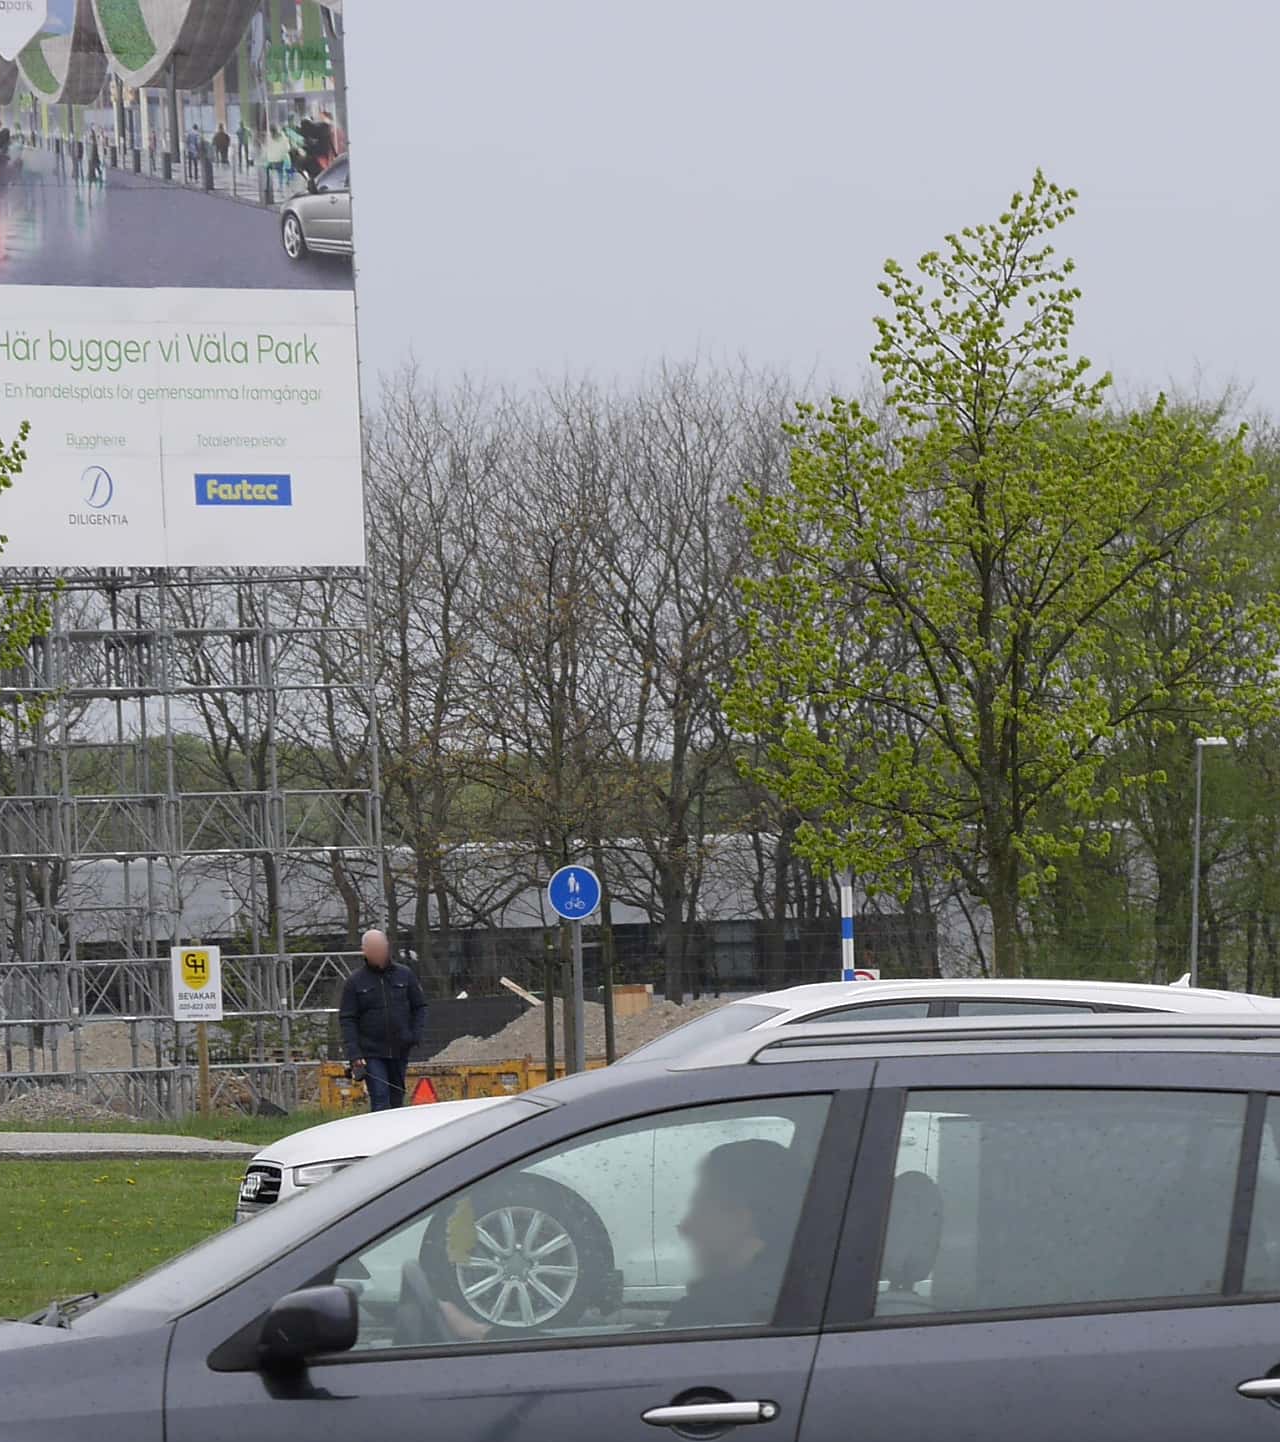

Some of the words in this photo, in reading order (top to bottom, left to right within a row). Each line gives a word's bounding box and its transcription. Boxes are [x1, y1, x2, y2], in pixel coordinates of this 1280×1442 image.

[48, 329, 151, 372] bygger
[158, 332, 180, 363] vi
[186, 331, 249, 364] Väla
[257, 333, 320, 365] Park
[4, 383, 24, 399] En
[25, 383, 114, 404] handelsplats
[136, 386, 240, 405] gemensamma
[206, 479, 279, 501] Fastec
[68, 513, 129, 526] DILIGENTIA
